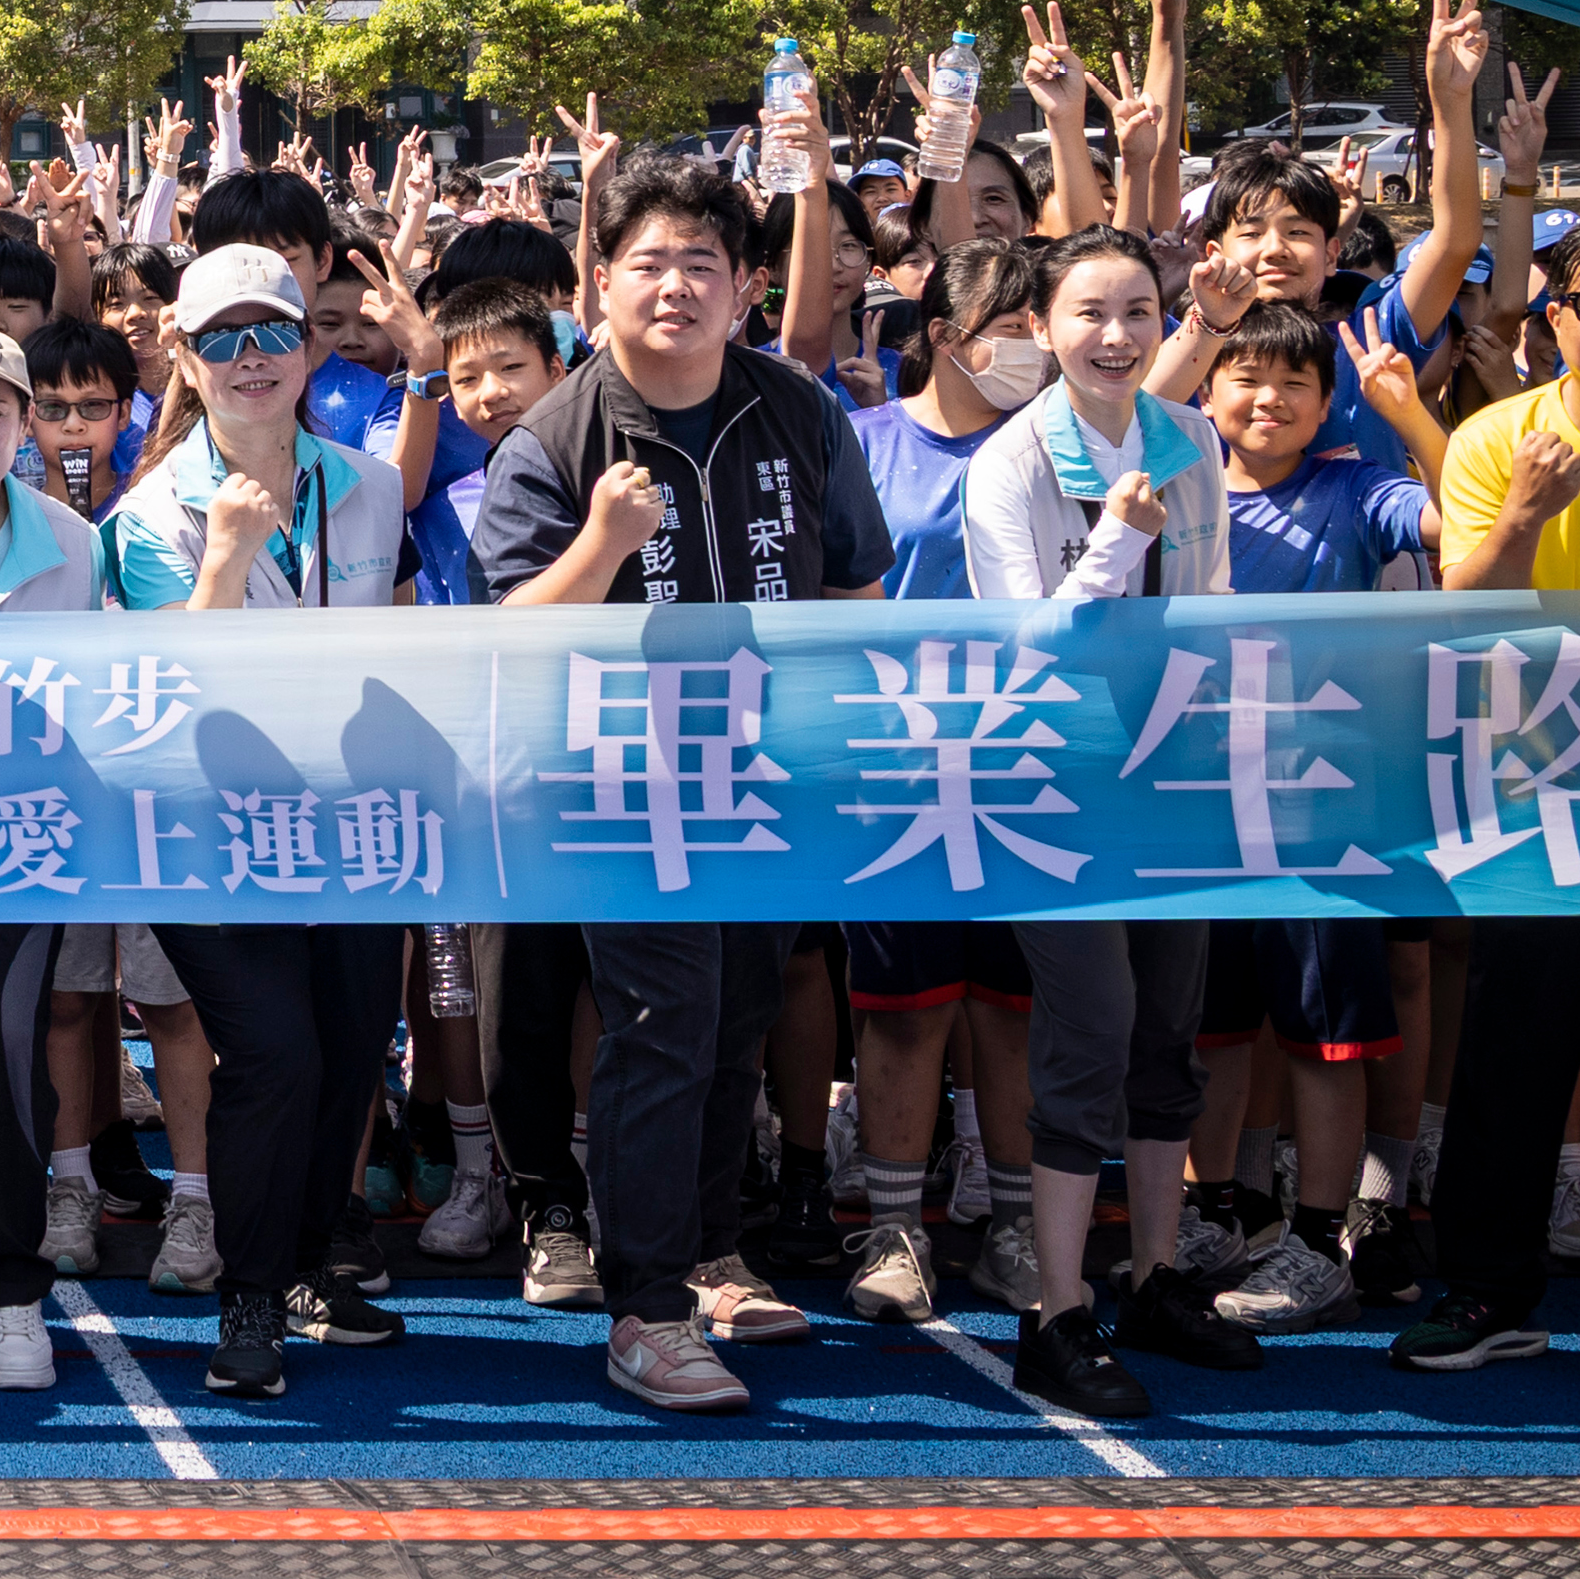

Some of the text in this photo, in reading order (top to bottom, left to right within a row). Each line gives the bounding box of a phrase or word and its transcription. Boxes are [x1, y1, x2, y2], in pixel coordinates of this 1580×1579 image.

[657, 482, 682, 530] 助理
[755, 461, 775, 492] 東區
[773, 458, 796, 535] 新竹市議員
[747, 517, 789, 603] 宋品
